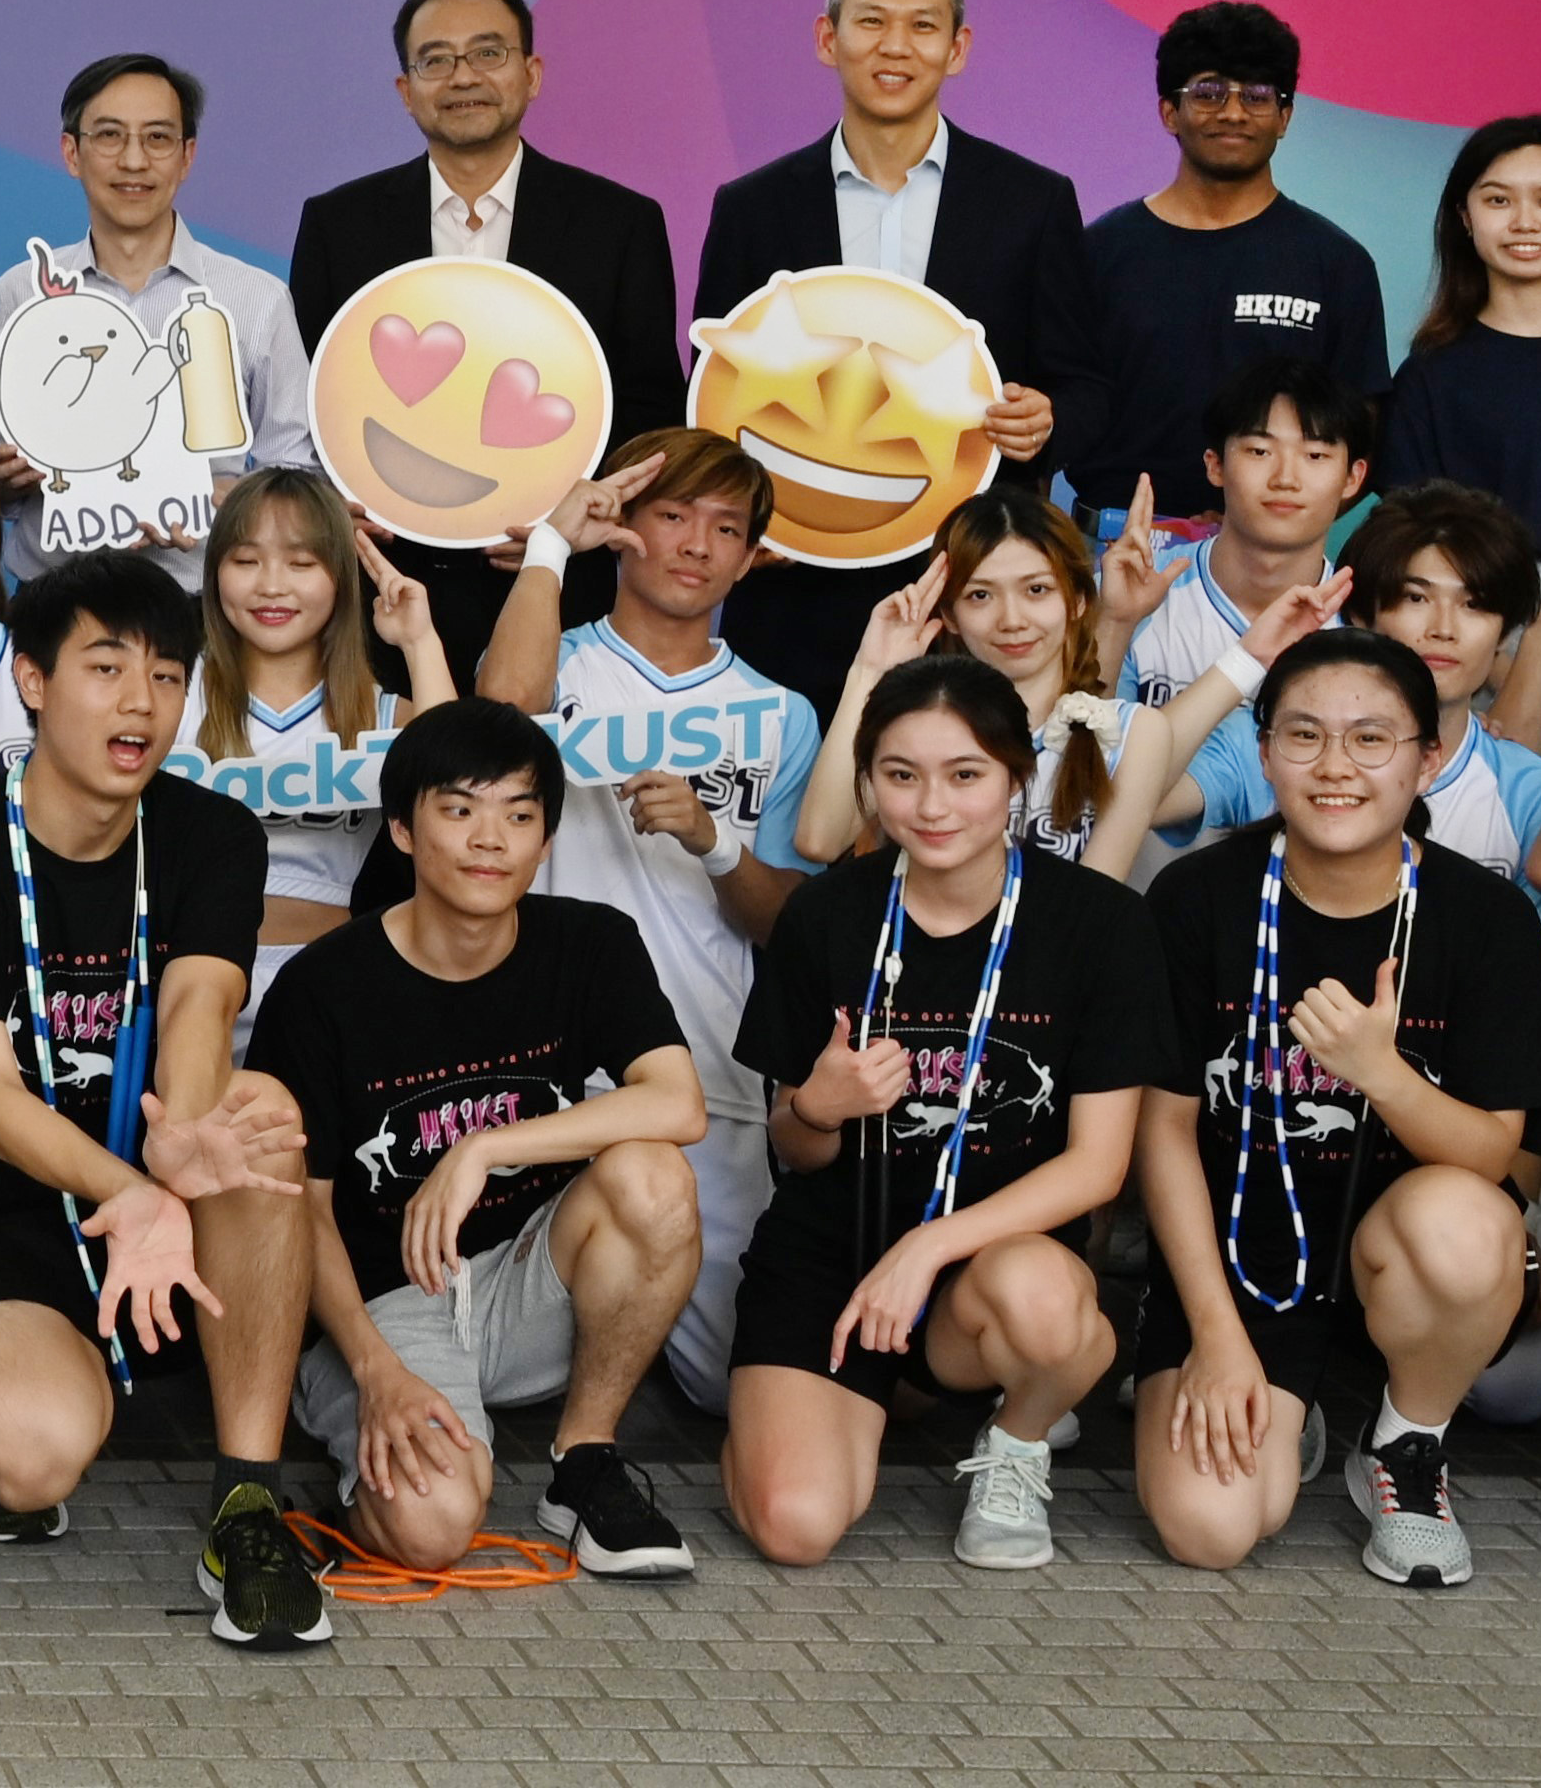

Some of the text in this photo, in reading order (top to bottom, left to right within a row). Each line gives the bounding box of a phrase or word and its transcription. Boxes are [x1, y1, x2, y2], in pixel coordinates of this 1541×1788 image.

[1234, 293, 1322, 325] HKUST
[47, 504, 140, 549] ADD
[999, 1012, 1053, 1026] TRUST
[1405, 1017, 1447, 1031] RUST
[394, 1067, 448, 1088] CHING
[438, 1091, 510, 1128] ROPE
